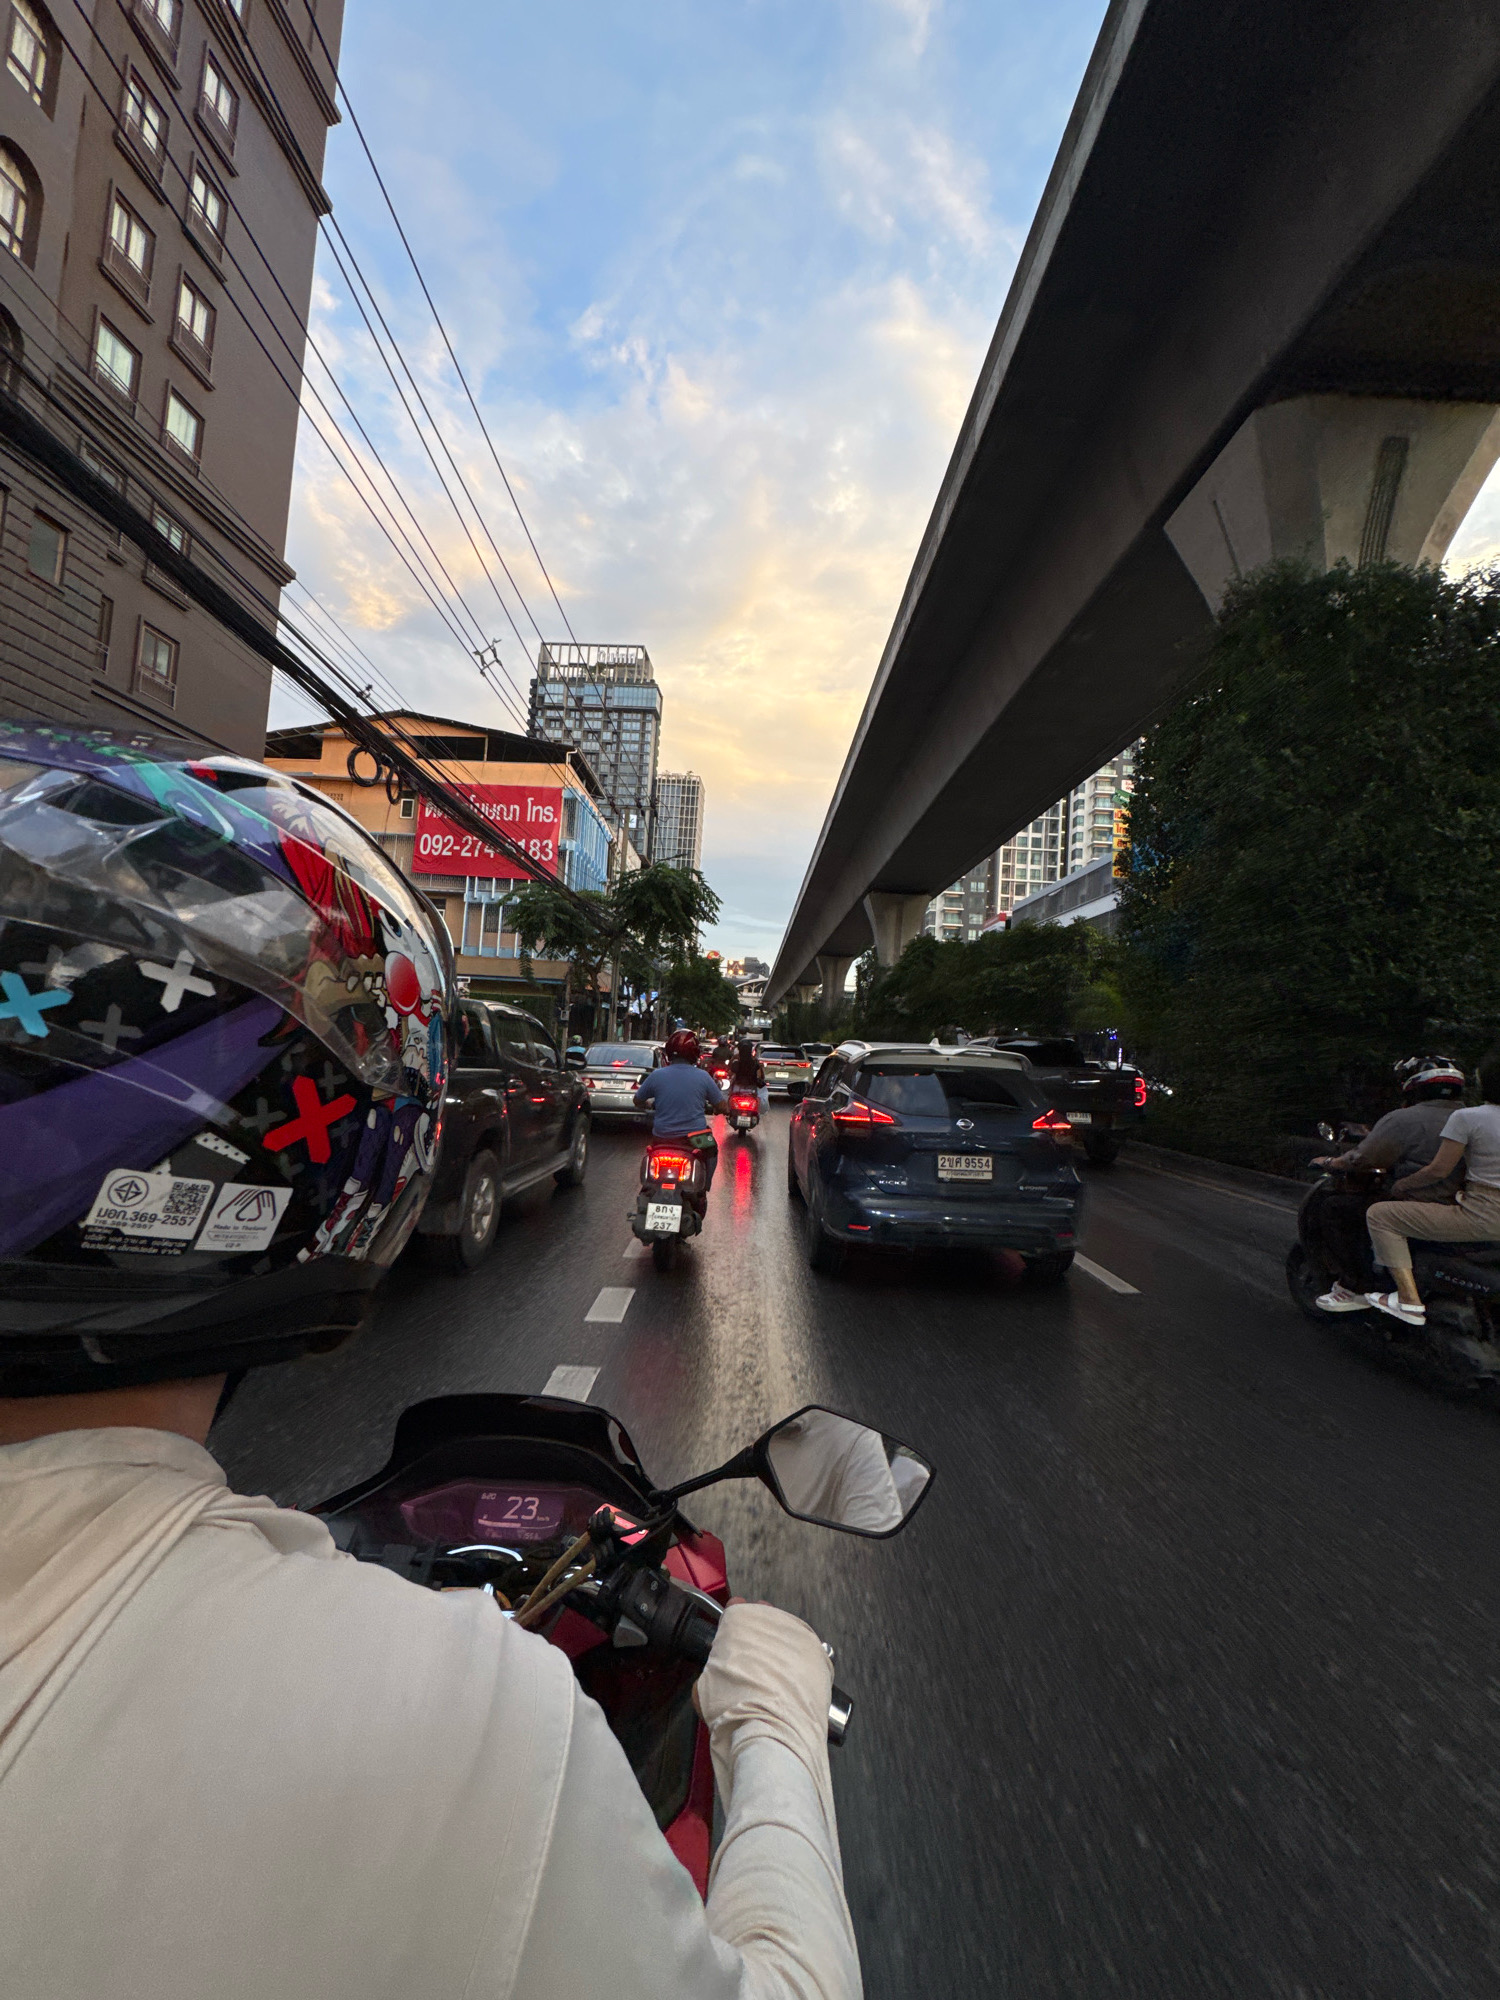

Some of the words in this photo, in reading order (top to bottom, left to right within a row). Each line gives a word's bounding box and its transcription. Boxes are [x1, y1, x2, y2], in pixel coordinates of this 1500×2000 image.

[526, 797, 558, 823] โทร.
[419, 833, 553, 862] 092-274183
[964, 1157, 990, 1169] 9554
[653, 1221, 672, 1230] 237
[502, 1496, 540, 1520] 23
